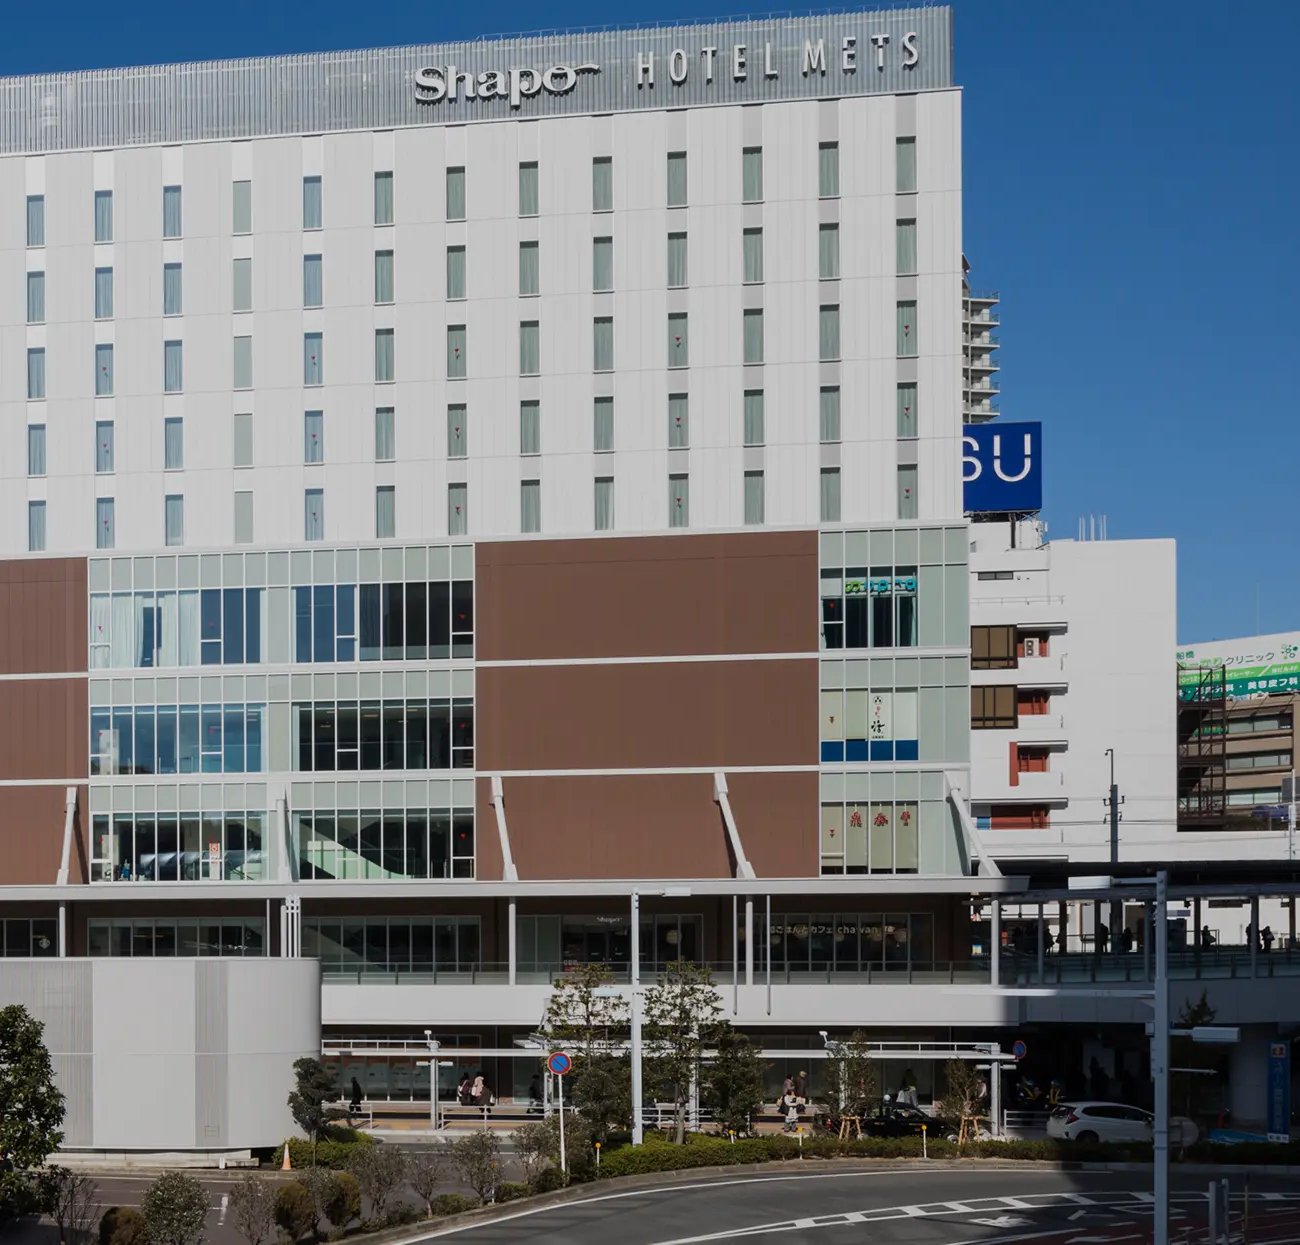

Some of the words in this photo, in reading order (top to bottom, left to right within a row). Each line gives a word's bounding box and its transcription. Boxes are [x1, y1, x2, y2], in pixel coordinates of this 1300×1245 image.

[414, 63, 600, 106] Shapo
[637, 42, 778, 85] HOTEL
[803, 31, 918, 72] METS
